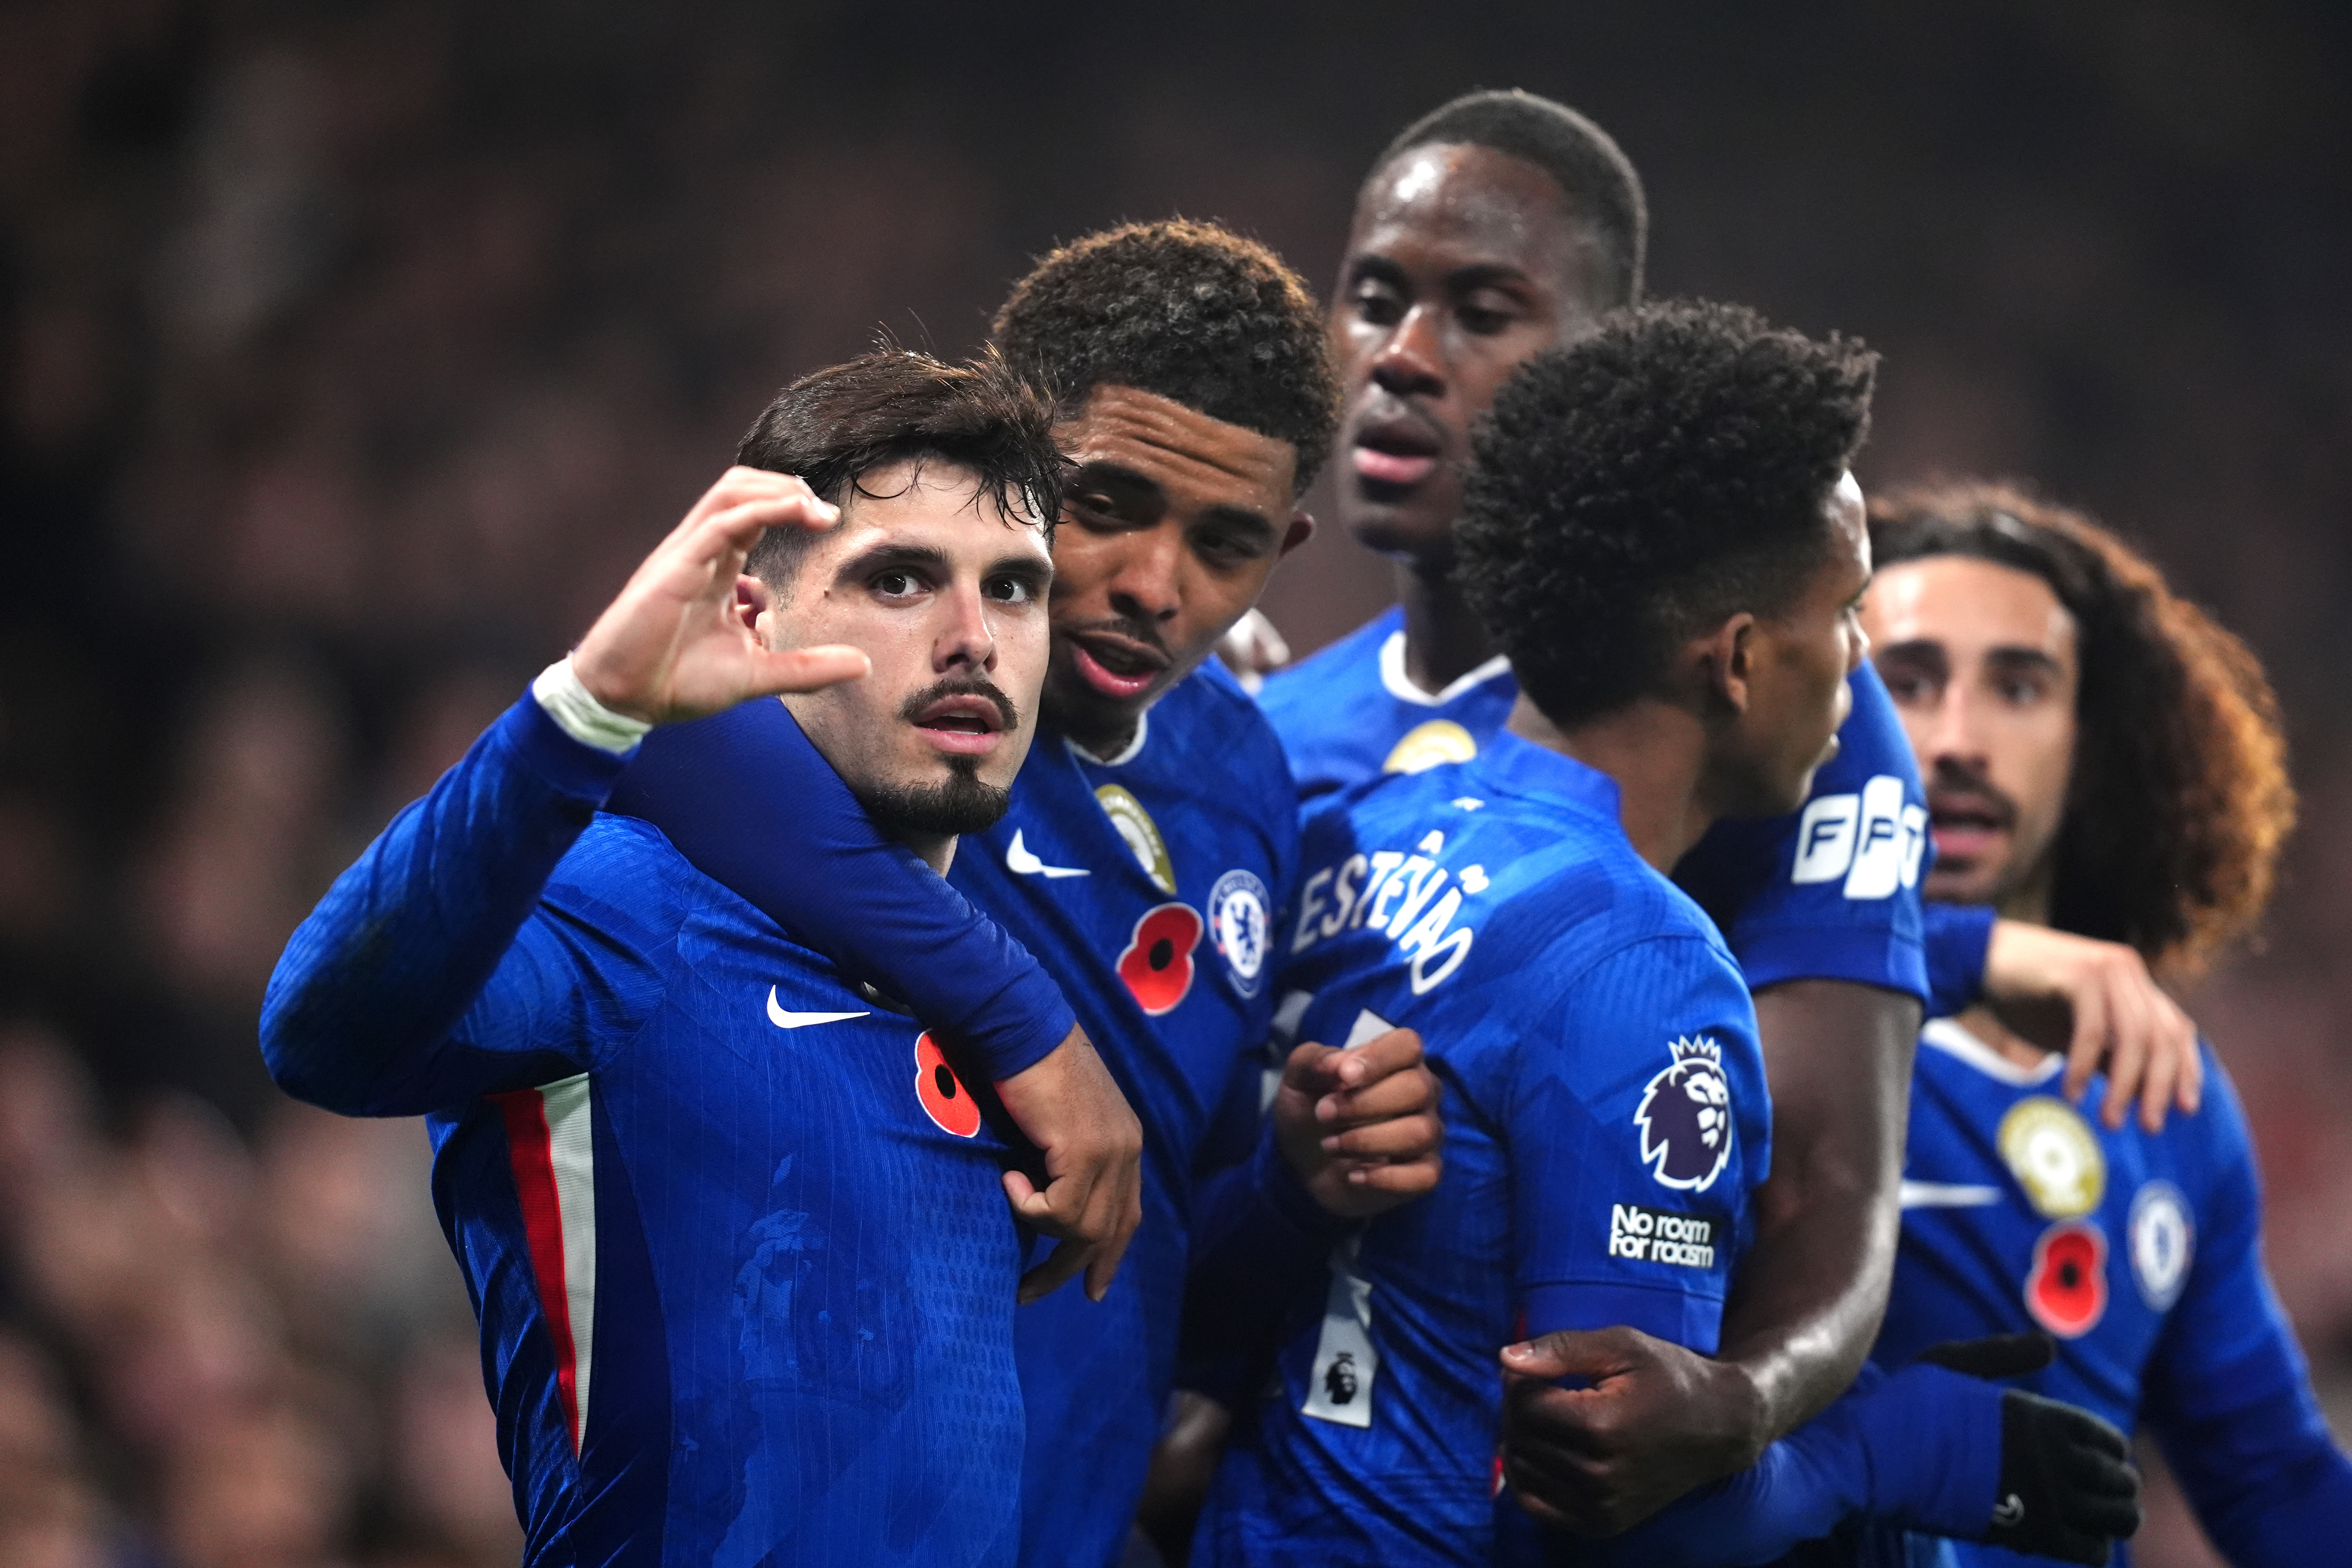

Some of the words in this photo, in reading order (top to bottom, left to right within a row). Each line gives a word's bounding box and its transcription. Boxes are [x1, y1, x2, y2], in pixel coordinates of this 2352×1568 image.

[1292, 830, 1490, 995] ESTÊVÃO
[1611, 1204, 1653, 1235] No
[1655, 1215, 1710, 1243] room
